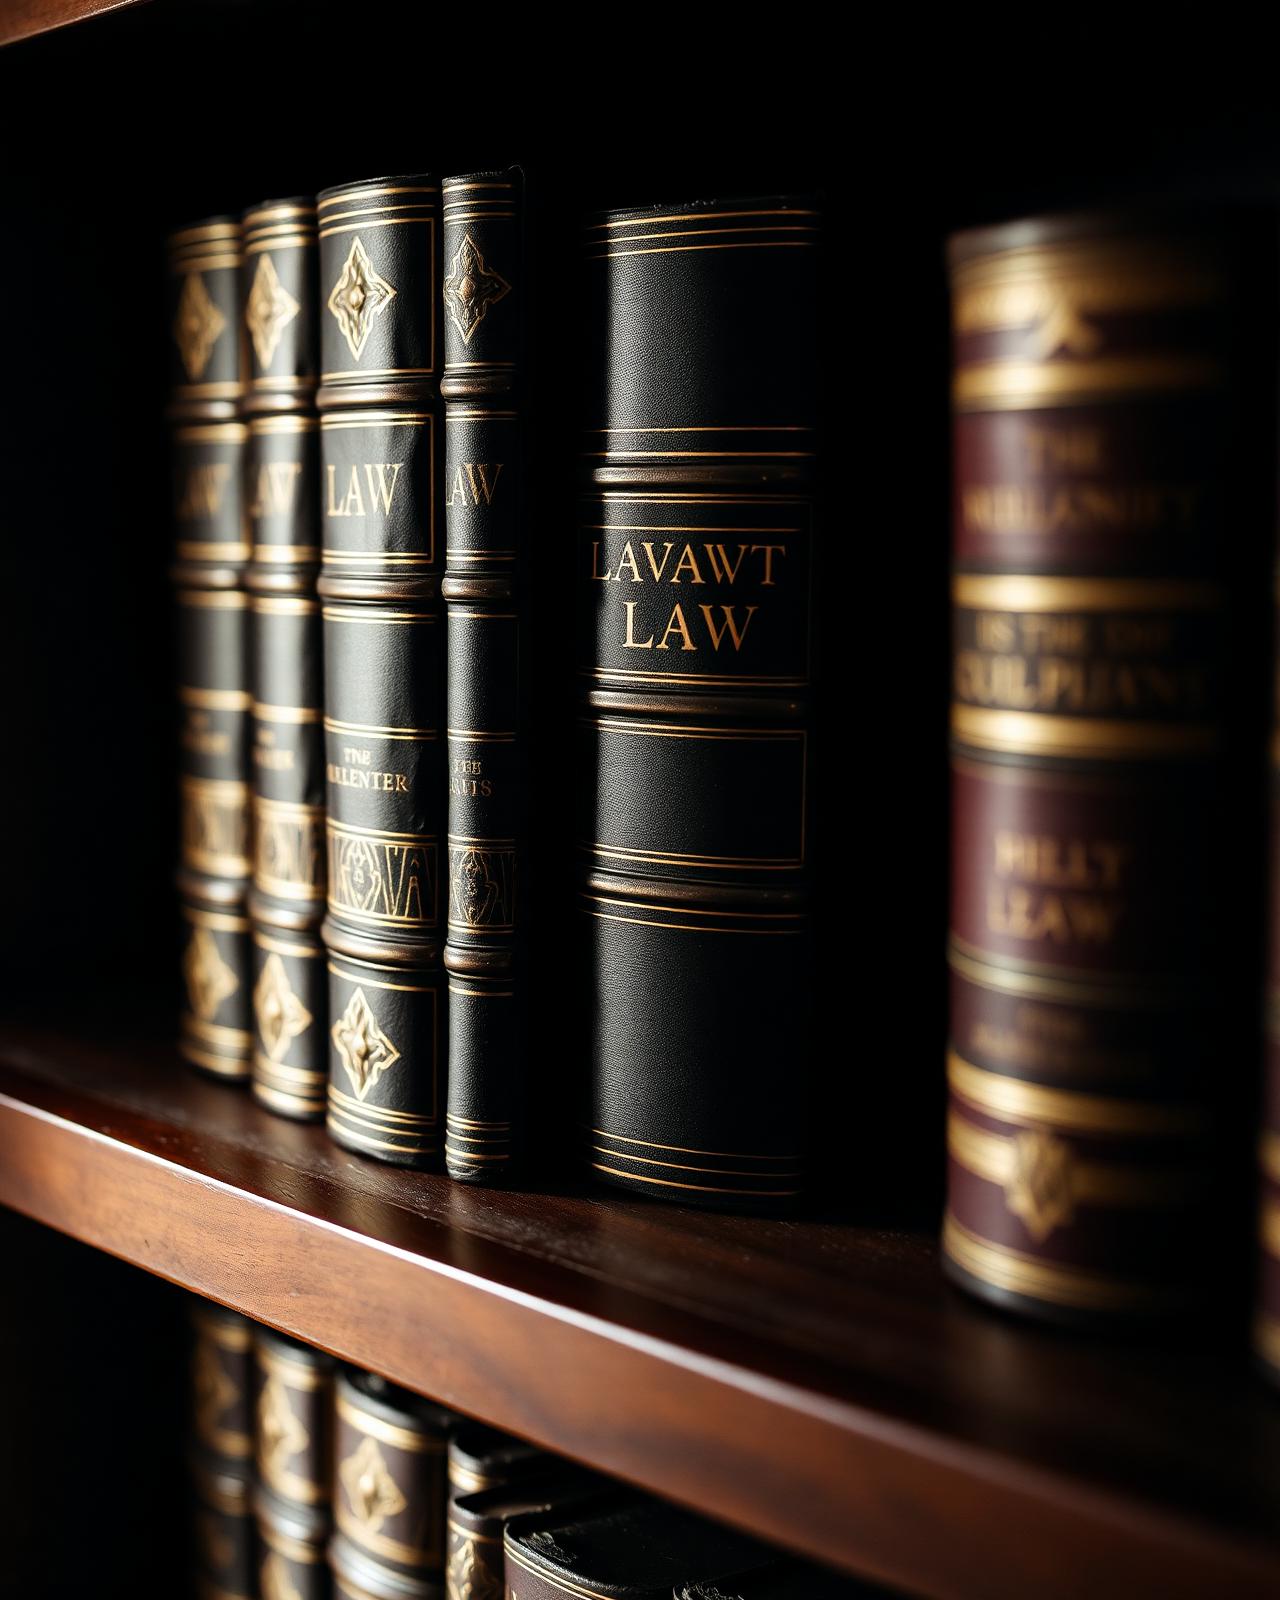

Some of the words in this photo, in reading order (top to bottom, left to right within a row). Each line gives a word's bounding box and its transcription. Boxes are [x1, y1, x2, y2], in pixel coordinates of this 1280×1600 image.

[326, 463, 404, 517] LAW
[446, 463, 504, 506] AW
[591, 541, 787, 587] LAVAWT
[622, 600, 761, 653] LAW
